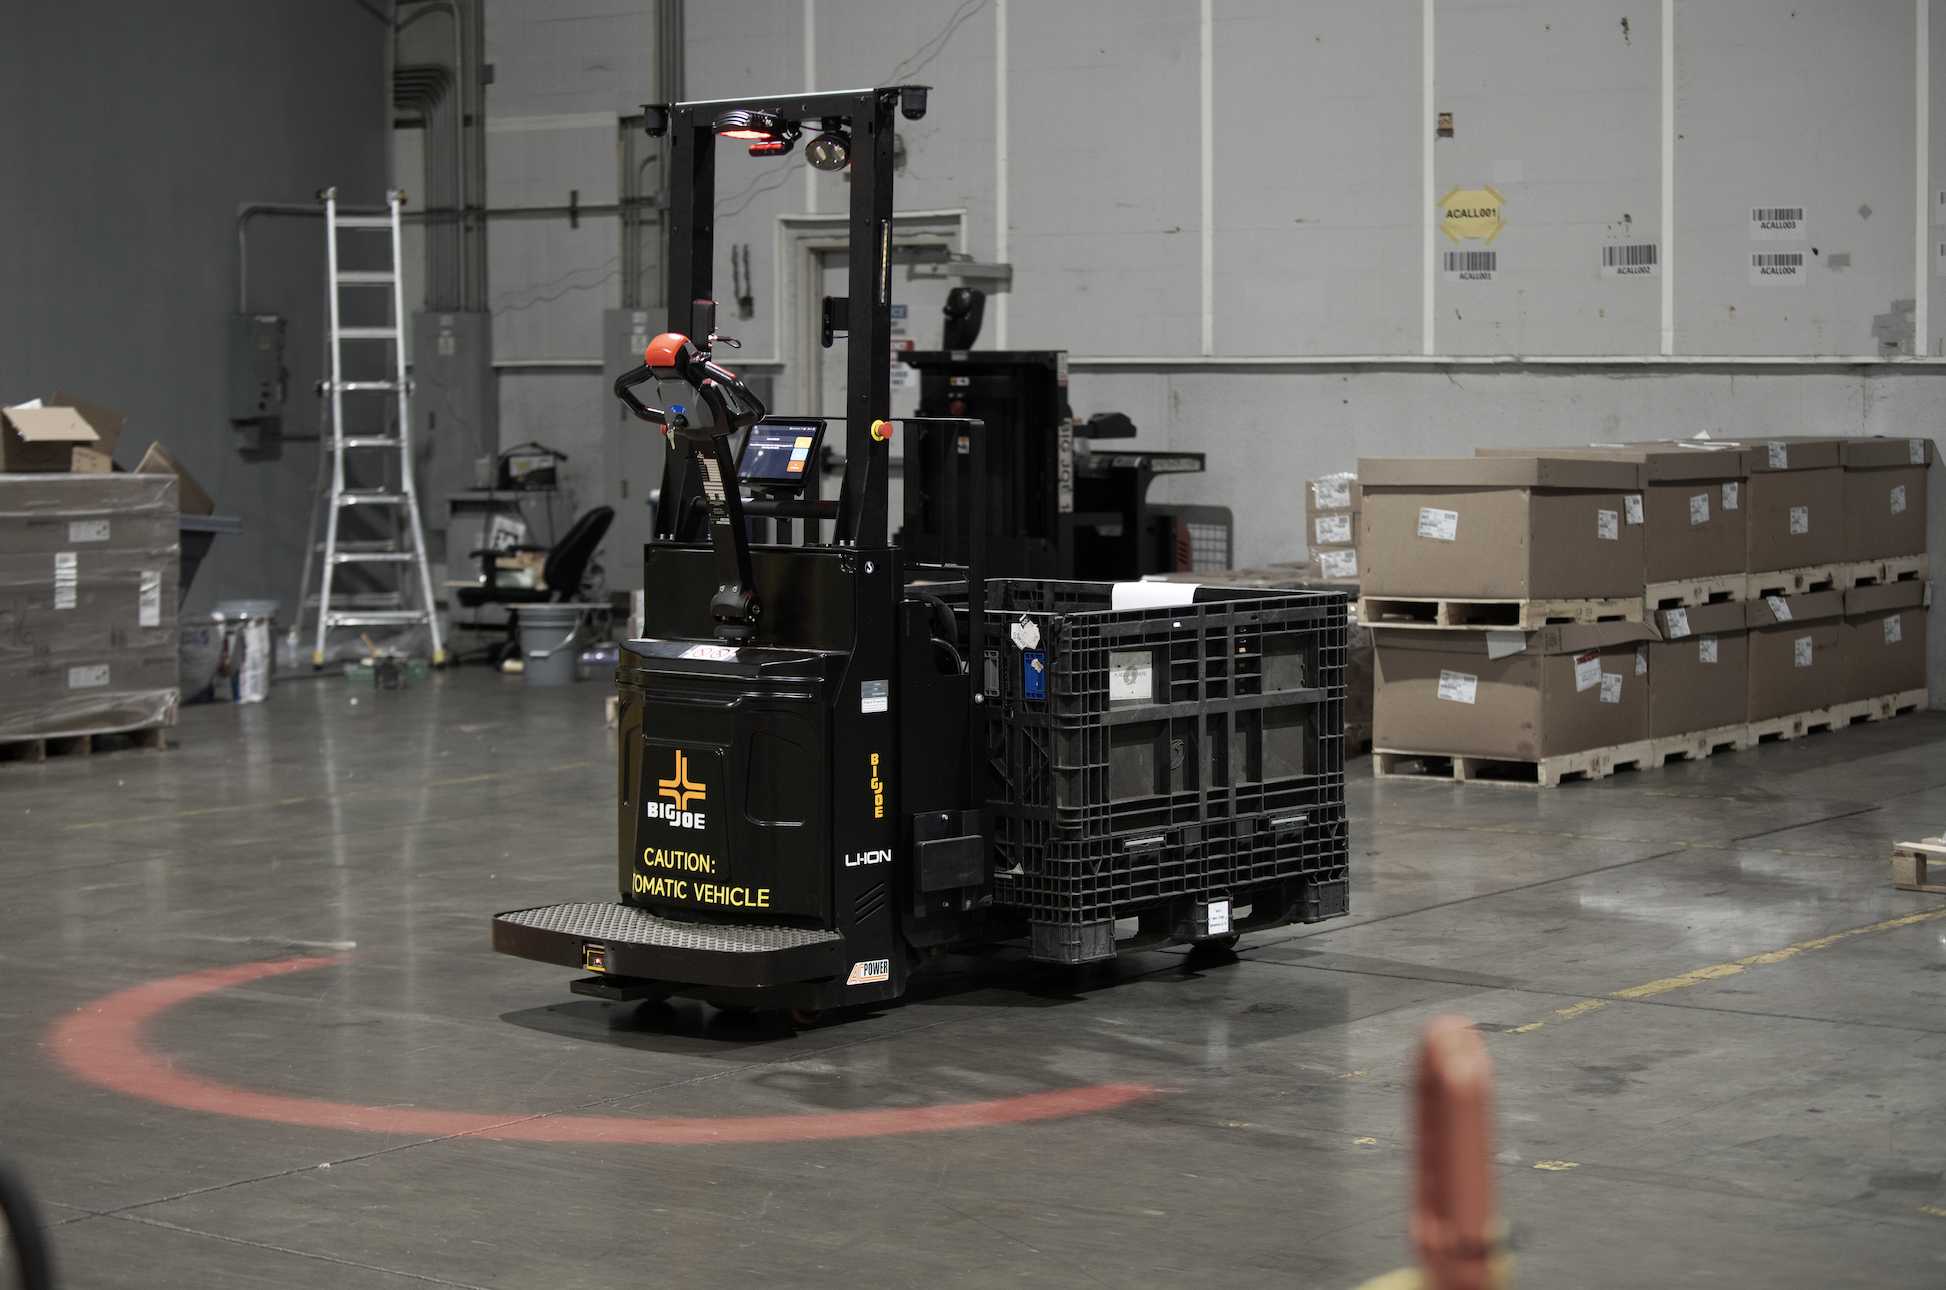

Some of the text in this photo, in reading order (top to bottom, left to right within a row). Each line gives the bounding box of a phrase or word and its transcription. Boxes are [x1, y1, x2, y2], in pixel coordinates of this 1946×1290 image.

[1446, 208, 1497, 219] ACALL001
[1760, 221, 1796, 229] ACALL003
[1616, 265, 1651, 275] ACALL002
[1760, 267, 1796, 275] ACALL004
[1459, 272, 1492, 280] ACALL001
[644, 847, 716, 874] CAUTION:
[694, 882, 770, 907] VEHICLE
[863, 961, 888, 976] POWER
